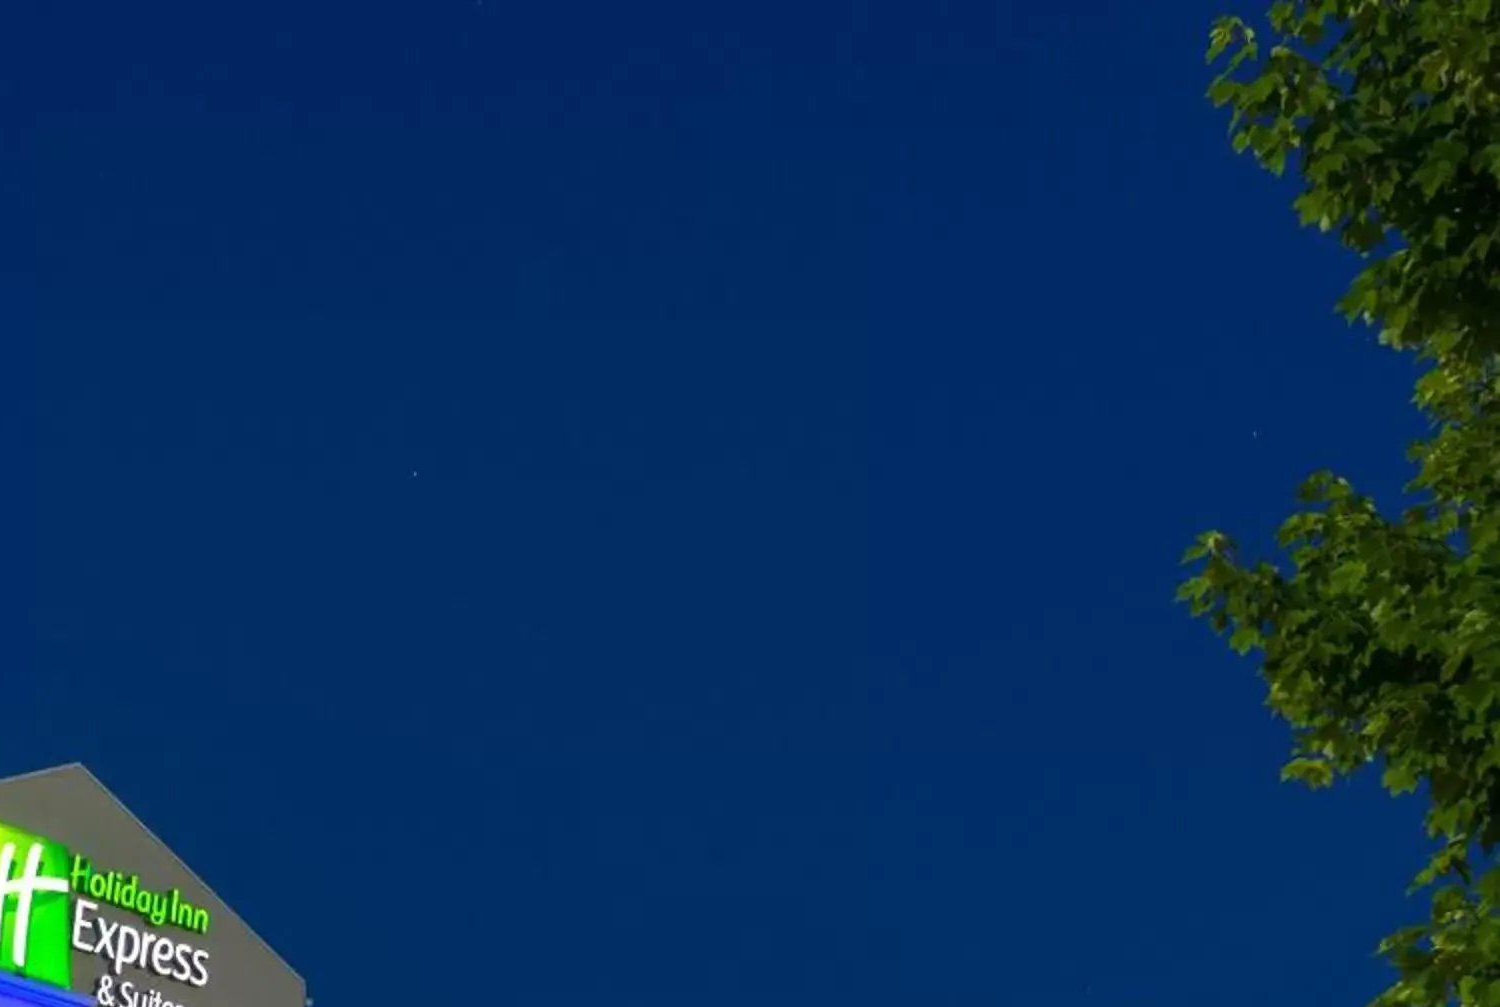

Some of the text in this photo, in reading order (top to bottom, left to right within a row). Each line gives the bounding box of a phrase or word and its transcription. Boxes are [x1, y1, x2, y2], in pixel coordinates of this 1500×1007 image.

[71, 853, 209, 933] Holiday Inn
[72, 898, 210, 986] Express
[97, 975, 116, 1007] &
